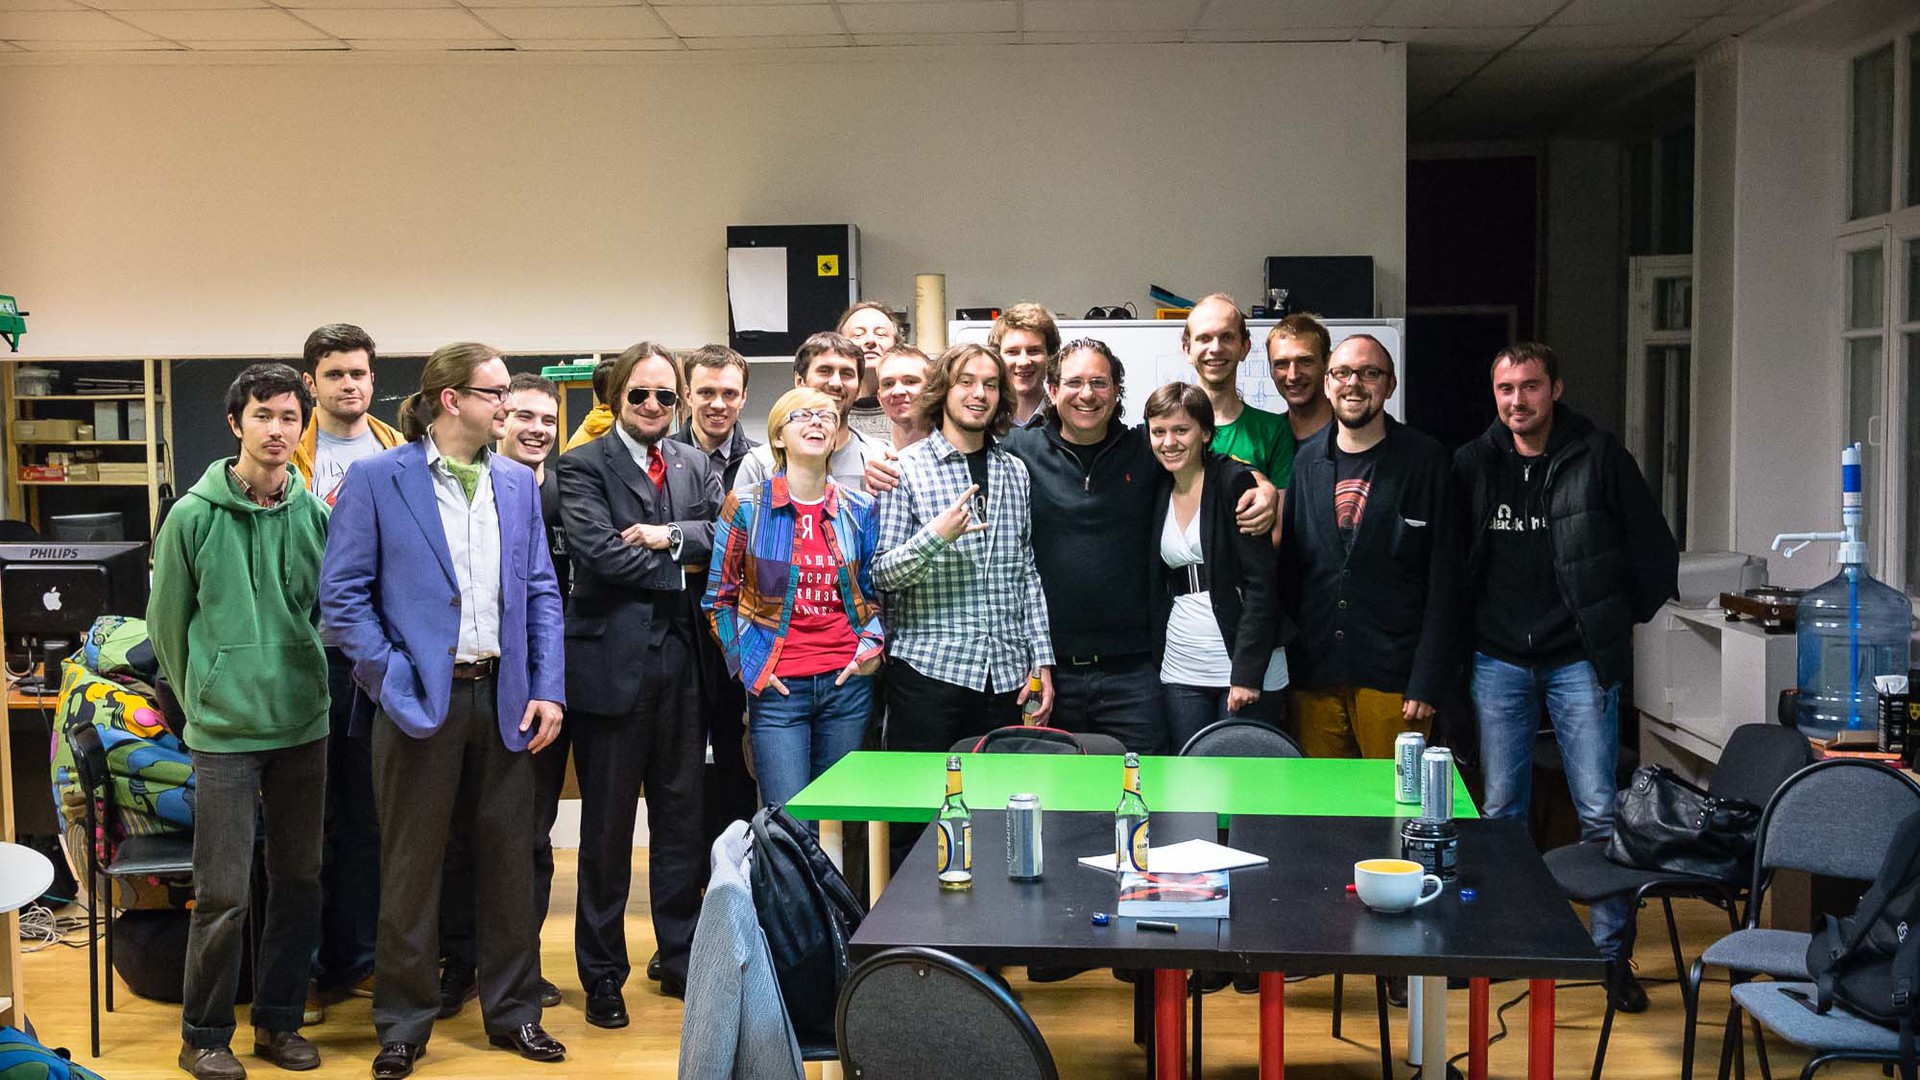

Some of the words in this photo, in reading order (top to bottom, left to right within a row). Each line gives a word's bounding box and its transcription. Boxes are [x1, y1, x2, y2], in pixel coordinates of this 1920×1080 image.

[802, 514, 813, 540] Я
[1488, 516, 1524, 531] lack
[29, 548, 79, 559] PHILIPS
[1403, 747, 1413, 793] Hoegaarden
